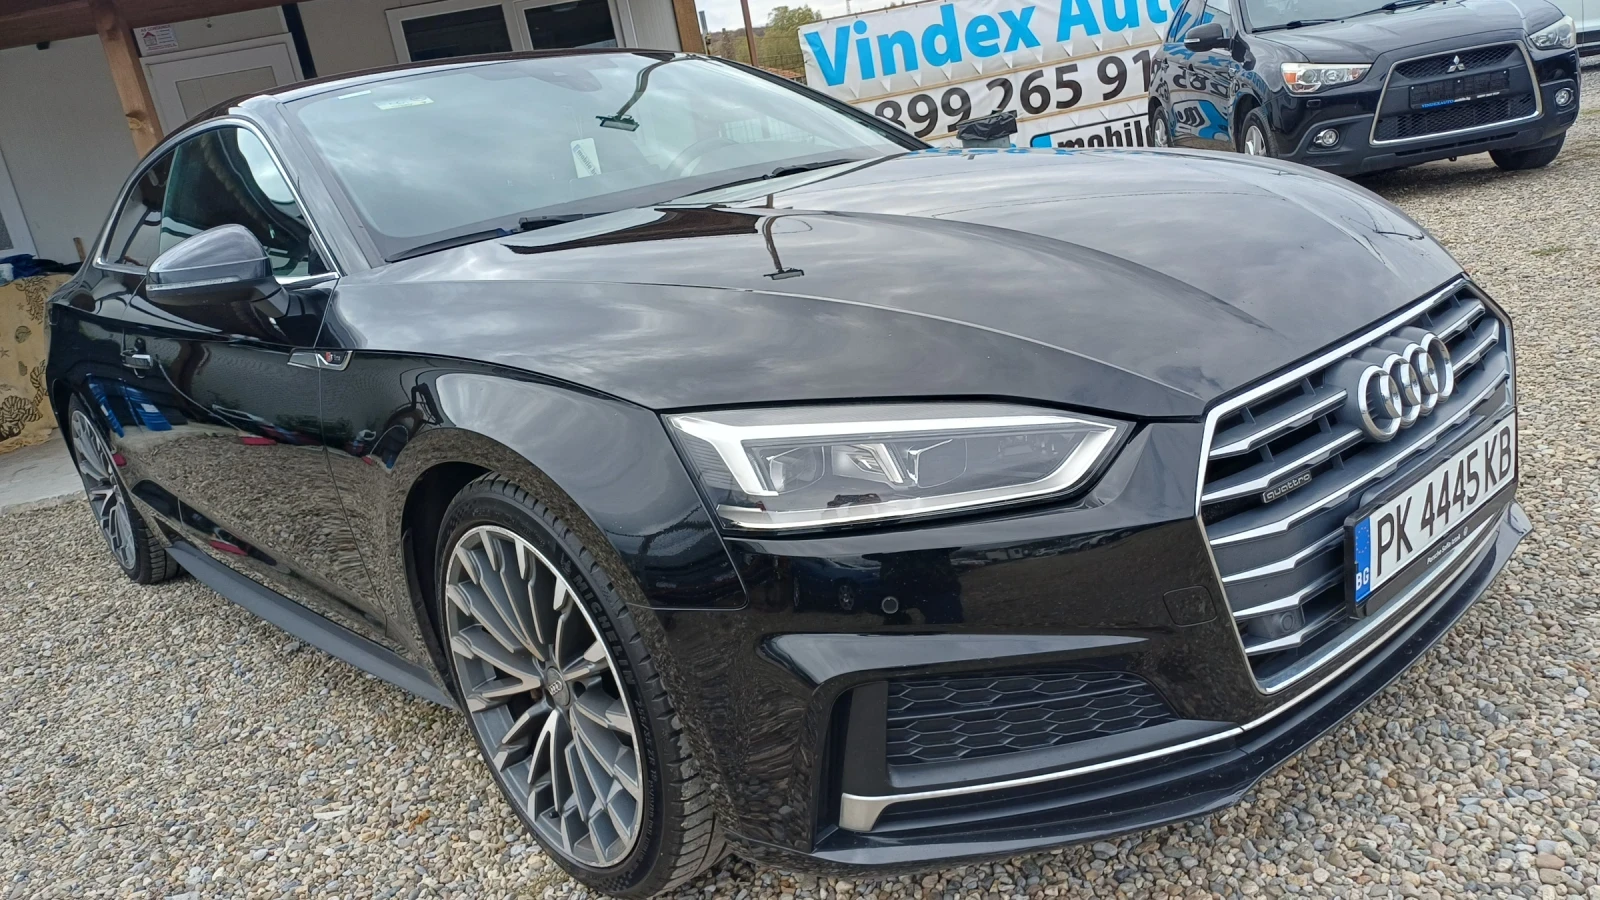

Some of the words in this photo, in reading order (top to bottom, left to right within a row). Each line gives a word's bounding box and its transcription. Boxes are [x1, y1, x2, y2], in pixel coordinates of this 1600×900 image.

[804, 3, 1041, 87] Vindex
[1056, 0, 1184, 43] Aut
[875, 86, 971, 139] 899
[986, 63, 1082, 115] 265
[1266, 473, 1310, 499] quattro
[1377, 495, 1413, 578] PK
[1421, 448, 1480, 538] 4445
[1484, 425, 1511, 494] KB
[1356, 567, 1370, 590] BG
[573, 574, 637, 685] MICHELIN
